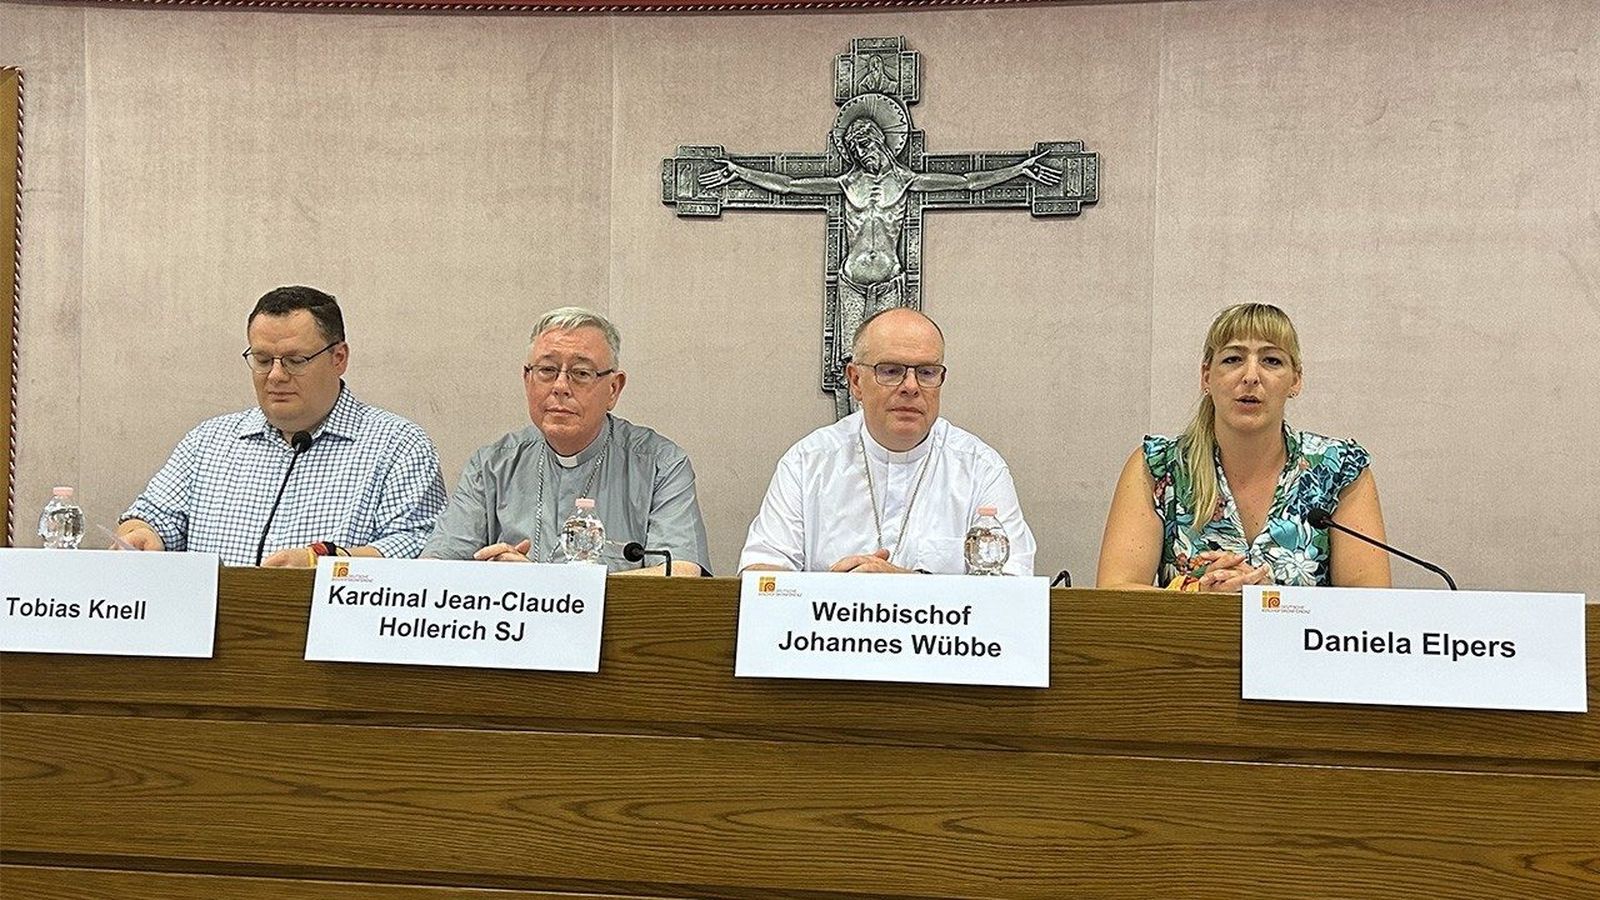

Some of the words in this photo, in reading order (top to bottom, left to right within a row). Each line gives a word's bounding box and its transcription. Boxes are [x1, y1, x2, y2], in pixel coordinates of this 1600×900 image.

[6, 596, 81, 618] Tobias
[88, 599, 147, 621] Knell
[328, 585, 428, 609] Kardinal
[434, 589, 585, 615] Jean-Claude
[812, 601, 972, 626] Weihbischof
[379, 616, 487, 641] Hollerich
[494, 620, 525, 642] SJ
[778, 630, 903, 654] Johannes
[911, 634, 1002, 658] Wübbe
[1304, 628, 1412, 655] Daniela
[1422, 632, 1516, 662] Elpers
